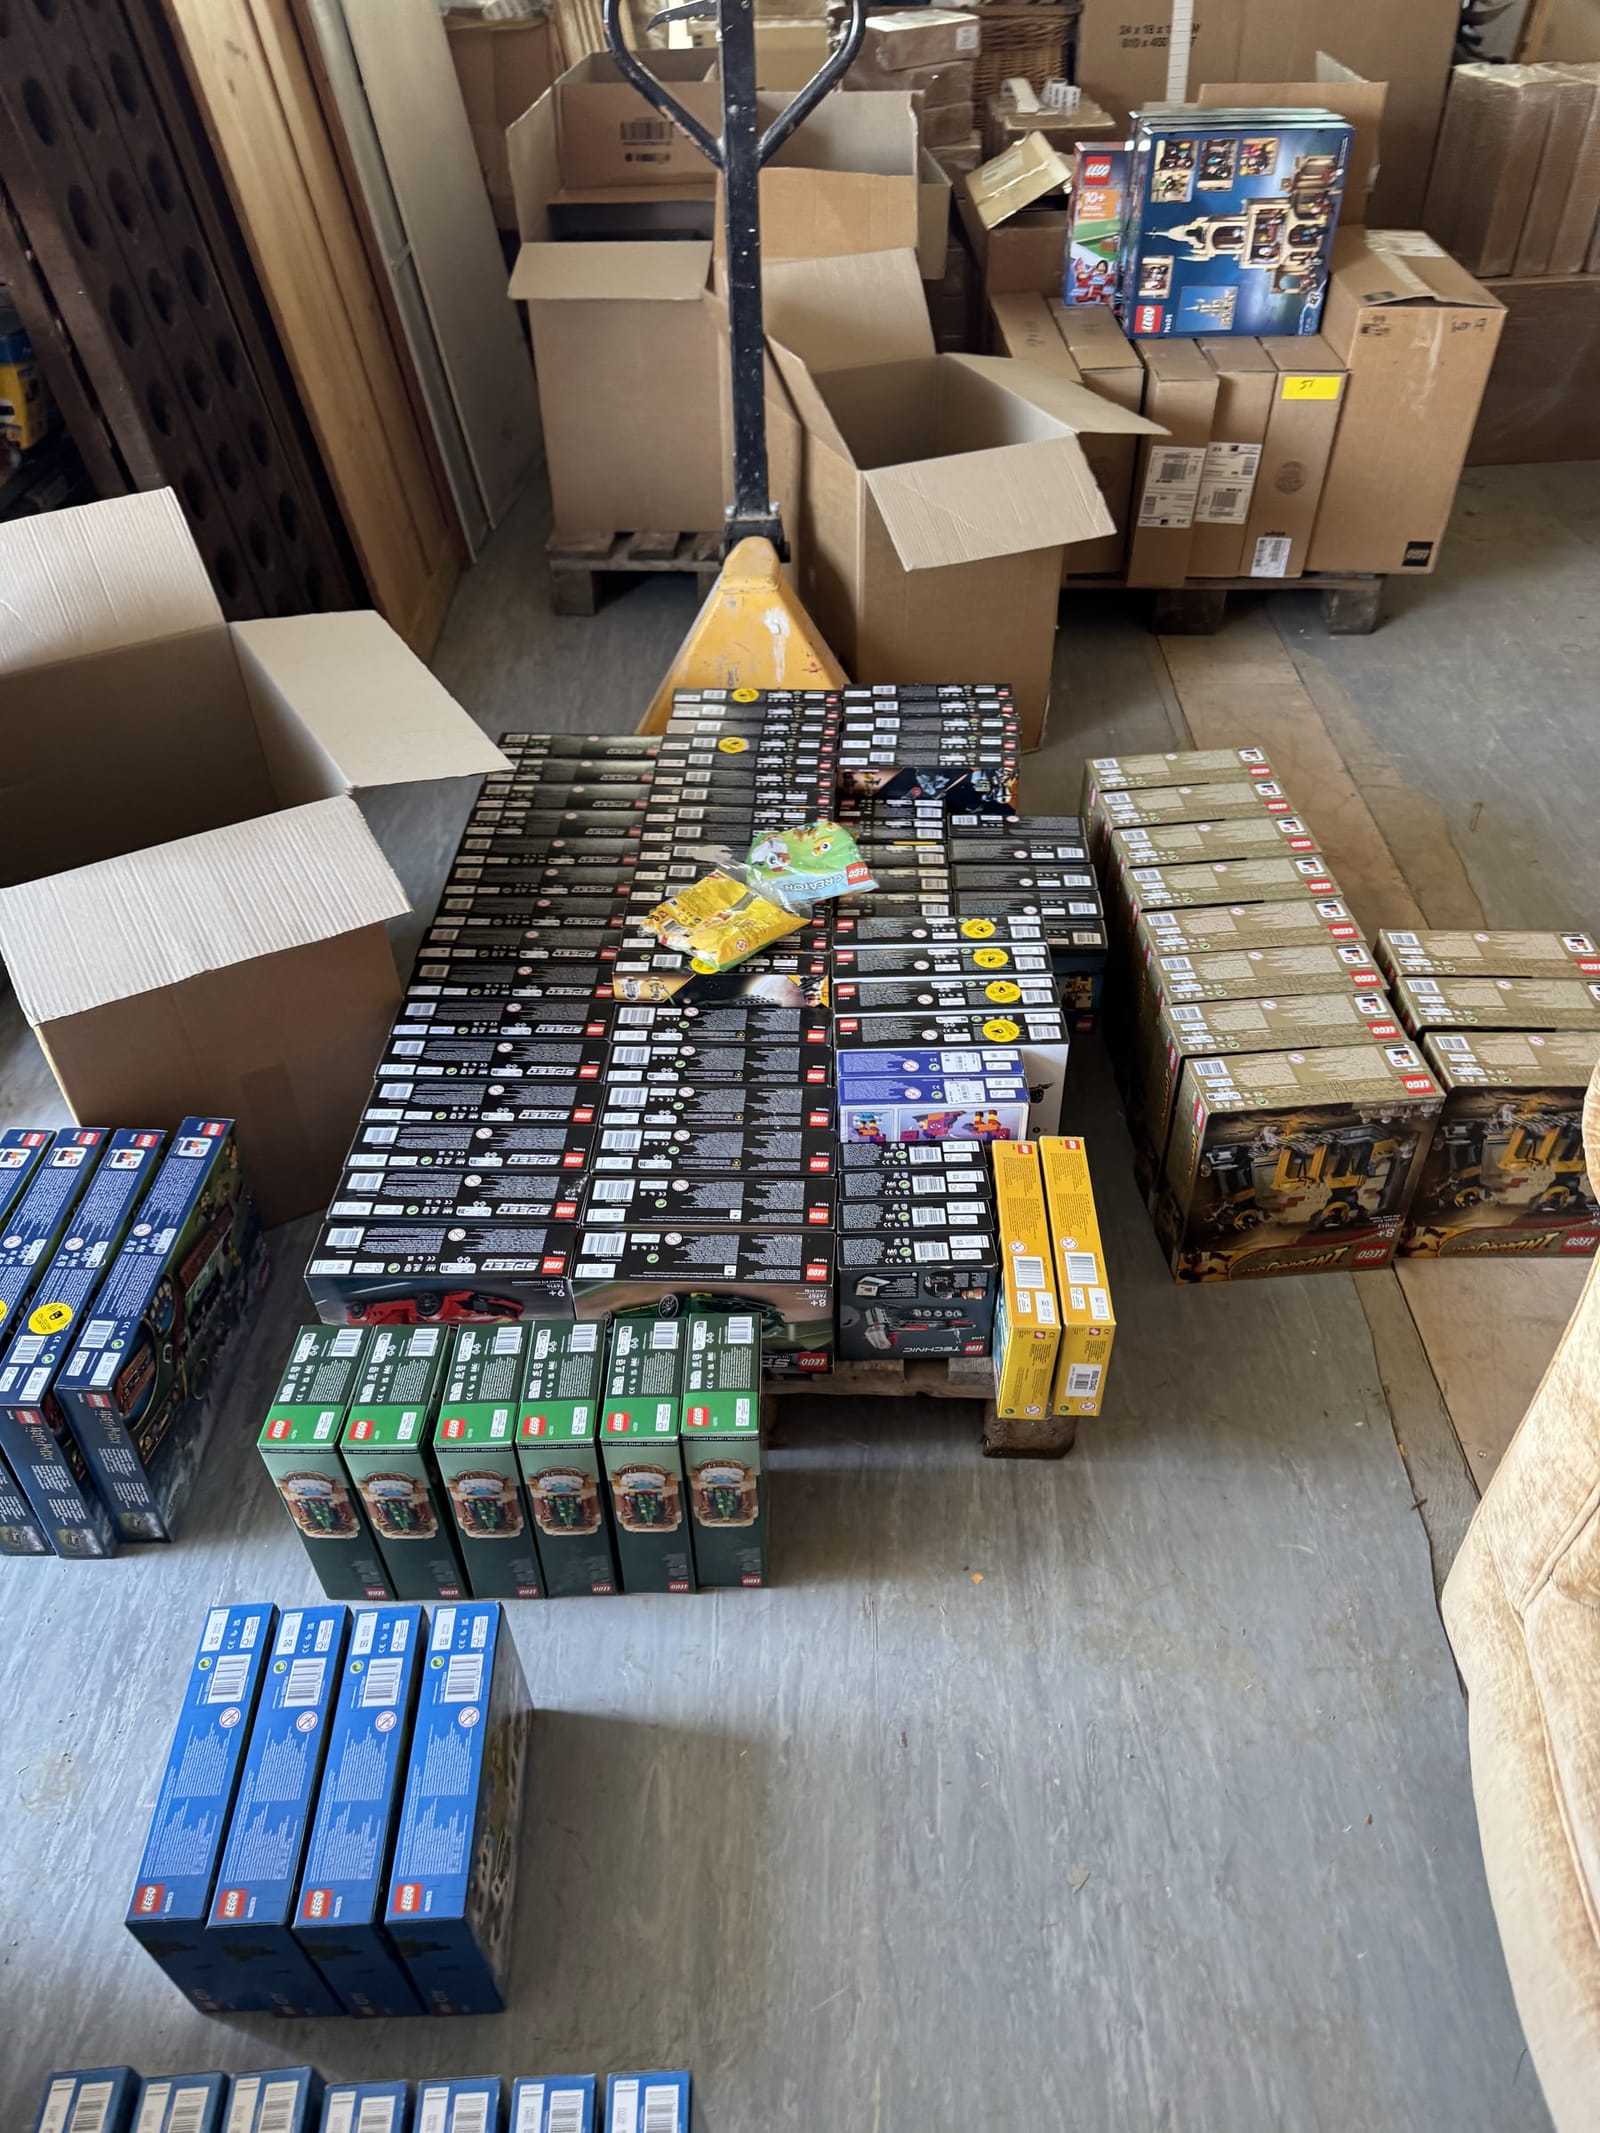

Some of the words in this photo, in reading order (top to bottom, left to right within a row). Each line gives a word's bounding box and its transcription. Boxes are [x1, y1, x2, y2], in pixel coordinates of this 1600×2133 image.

[1085, 192, 1106, 204] 10+
[1142, 306, 1155, 332] LEGO
[848, 868, 867, 878] LEGO
[784, 875, 843, 892] CREATOR
[506, 1156, 560, 1165] SPEED
[496, 1206, 552, 1215] SPEED
[1375, 1228, 1395, 1237] 8+
[1566, 1237, 1595, 1245] LEGO
[1358, 1249, 1386, 1259] LEGO
[481, 1262, 538, 1271] SPEED
[544, 1261, 563, 1269] LEGO
[549, 1289, 565, 1297] 9+
[965, 1344, 983, 1352] LEGO
[801, 1358, 825, 1366] LEGO
[613, 1413, 623, 1431] LEGO
[693, 1408, 703, 1425] LEGO
[272, 1420, 285, 1438] LEGO
[355, 1421, 367, 1439] LEGO
[448, 1420, 459, 1437] LEGO
[529, 1417, 539, 1435] LEGO
[142, 1887, 156, 1911] LEGO
[225, 1892, 238, 1917] LEGO
[311, 1891, 324, 1917] LEGO
[401, 1885, 414, 1911] LEGO
